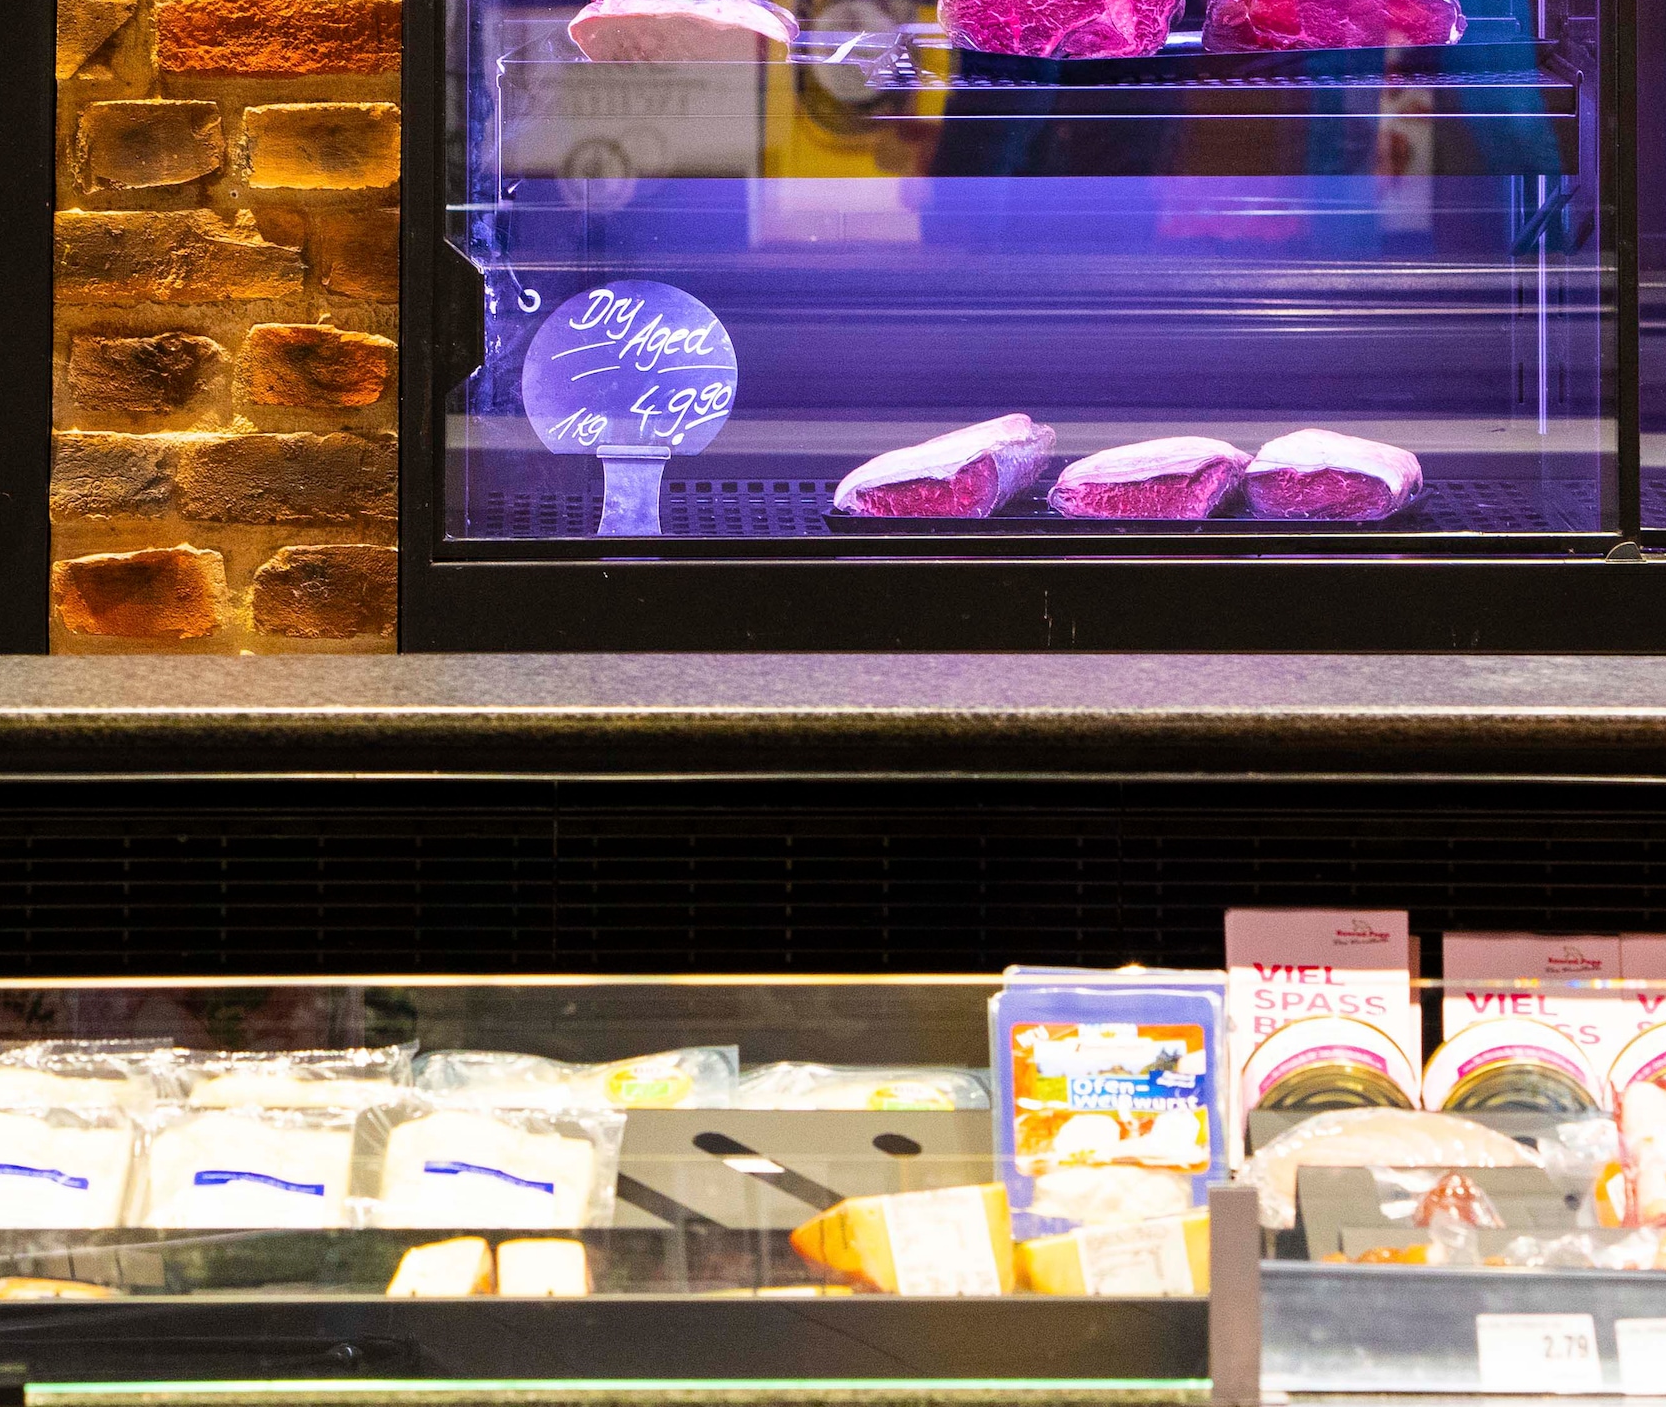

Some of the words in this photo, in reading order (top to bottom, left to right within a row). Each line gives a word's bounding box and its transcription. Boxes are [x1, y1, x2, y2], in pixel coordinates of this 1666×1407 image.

[569, 289, 645, 340] Dry
[619, 313, 719, 372] Aged
[1253, 962, 1346, 987] VIEL
[1254, 988, 1387, 1016] SPASS
[1465, 991, 1558, 1016] VIEL
[1072, 1078, 1150, 1096] Ofen-
[1543, 1334, 1589, 1360] 2.79
